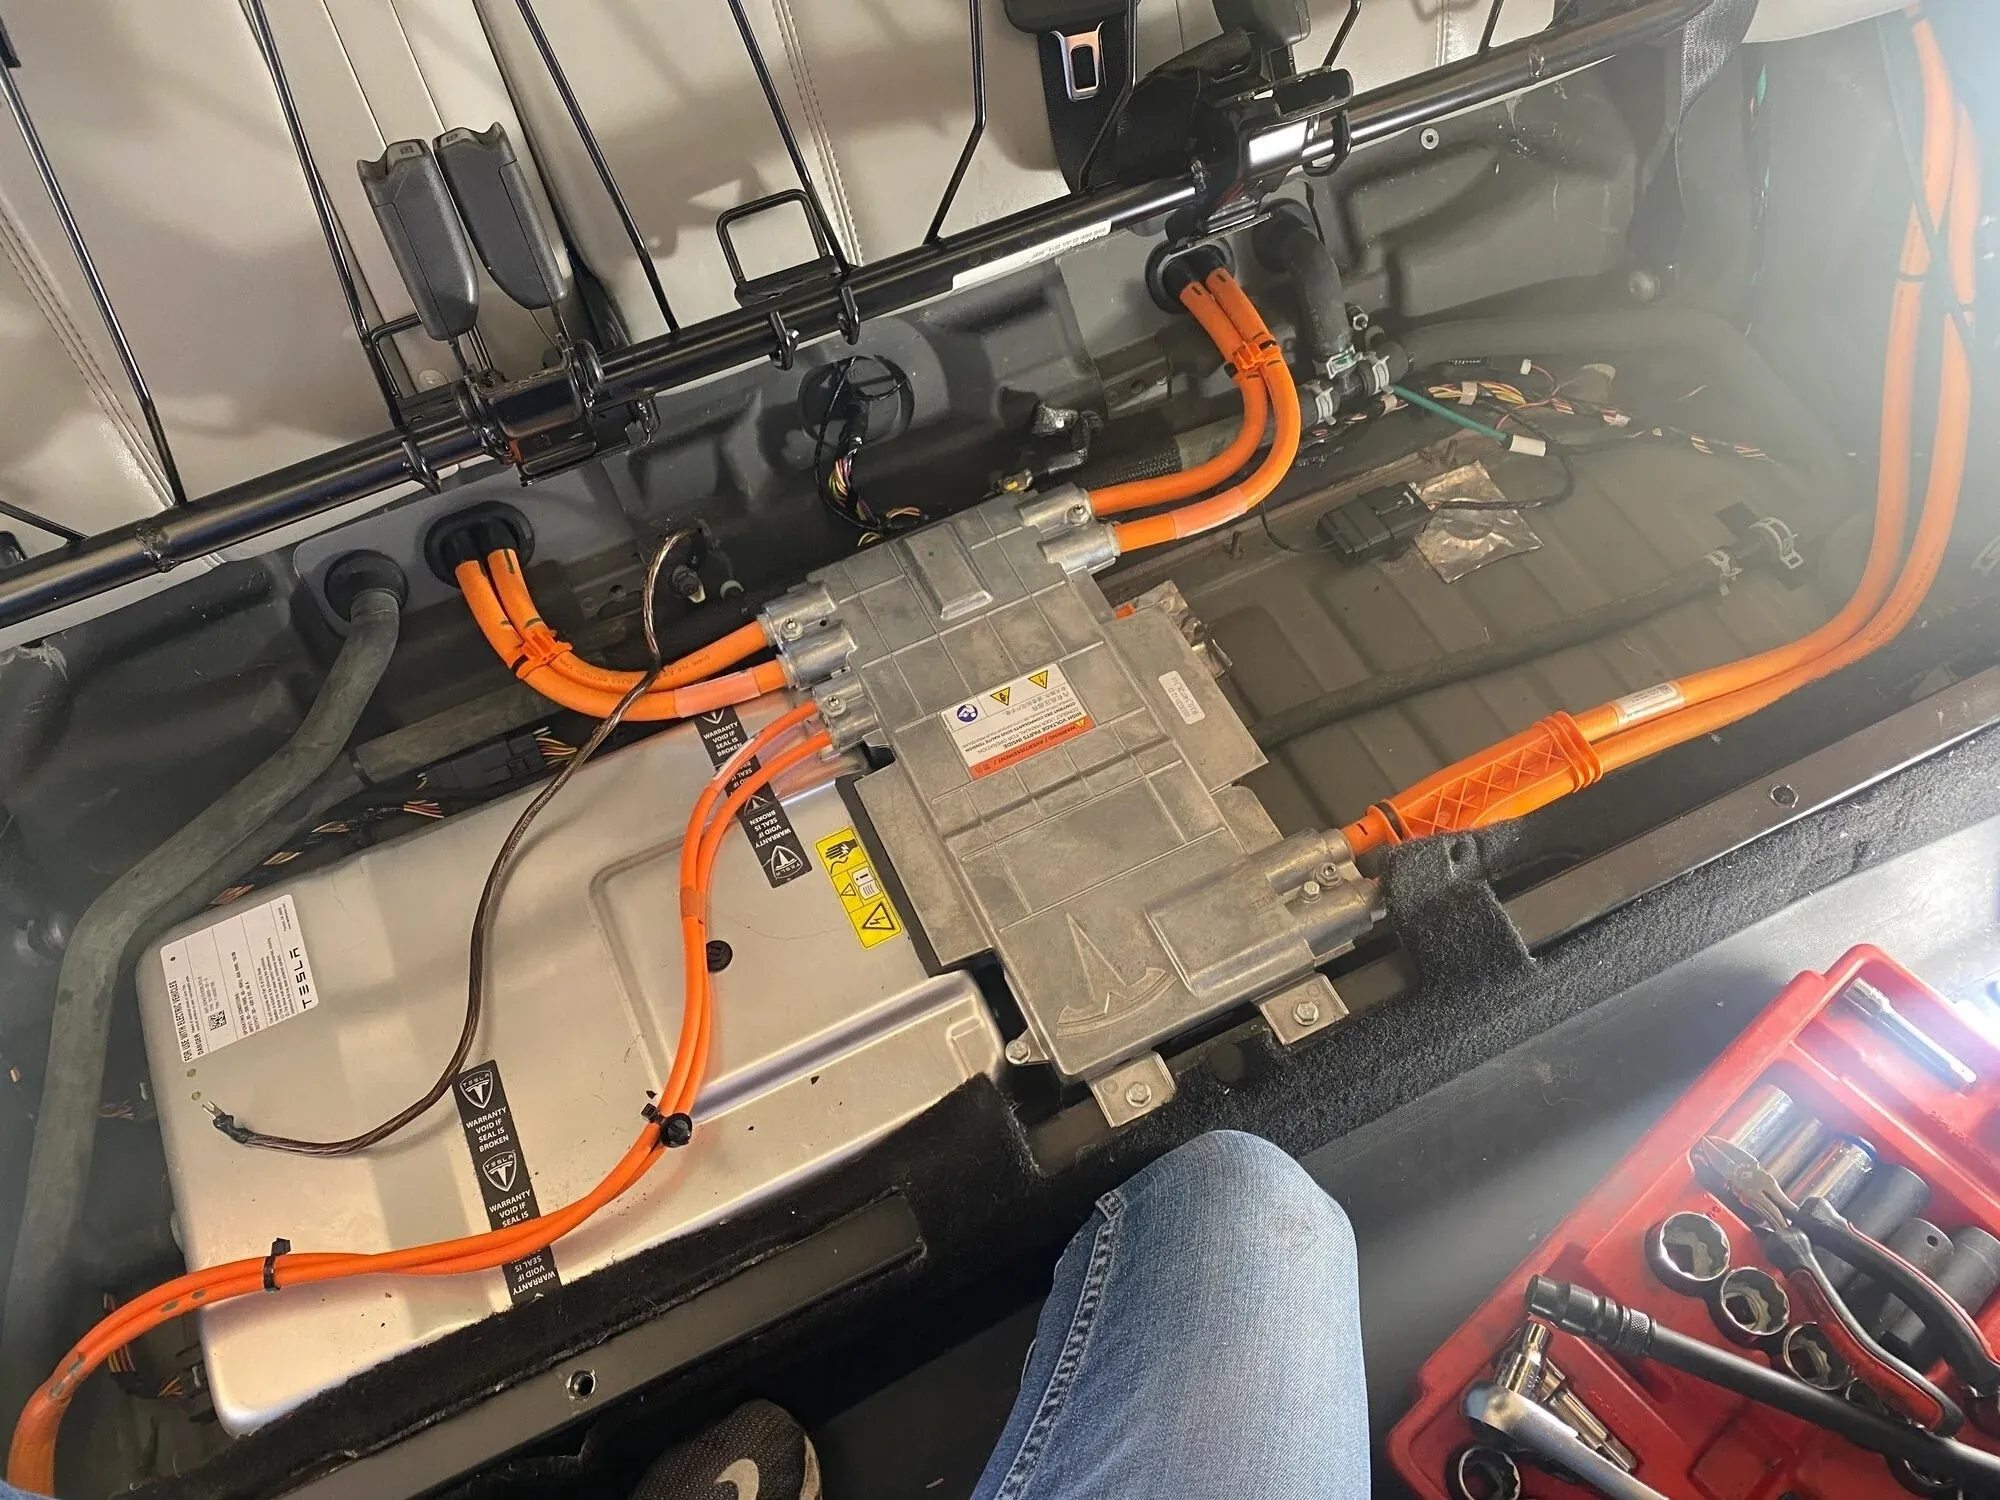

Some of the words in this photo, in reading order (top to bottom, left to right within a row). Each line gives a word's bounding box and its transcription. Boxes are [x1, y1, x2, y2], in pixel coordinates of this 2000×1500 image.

[1067, 711, 1081, 720] HIGH
[704, 722, 737, 739] WARRANTY
[1041, 718, 1066, 731] VOLTAGE
[713, 734, 728, 743] VOID
[1023, 729, 1040, 739] PARTS
[1048, 725, 1076, 740] WARNING
[716, 741, 731, 749] SEAL
[1003, 737, 1021, 748] INSIDE
[717, 743, 744, 756] BROKEN
[750, 810, 776, 825] BROKEN
[761, 817, 777, 827] SEAL
[765, 825, 781, 834] VOID
[756, 828, 791, 848] WARRANTY
[775, 862, 801, 877] TESLA
[289, 947, 312, 1008] TESLA
[169, 980, 180, 1003] VEHICLES
[174, 1002, 184, 1025] ELECTRIC
[179, 1025, 187, 1038] WITH
[194, 1033, 203, 1054] DANGER
[183, 1049, 191, 1060] FOR
[461, 1072, 490, 1088] TESLA
[466, 1107, 506, 1128] WARRANTY
[476, 1122, 494, 1133] VOID
[479, 1131, 497, 1142] SEAL
[479, 1135, 508, 1152] BROKEN
[484, 1155, 514, 1170] TESLA
[489, 1190, 530, 1212] WARRANTY
[499, 1206, 518, 1218] VOID
[502, 1215, 521, 1229] SEAL
[521, 1211, 528, 1219] IS
[523, 1256, 541, 1268] SEAL
[526, 1265, 545, 1277] VOID
[513, 1271, 555, 1295] WARRANTY
[518, 1274, 524, 1282] IF
